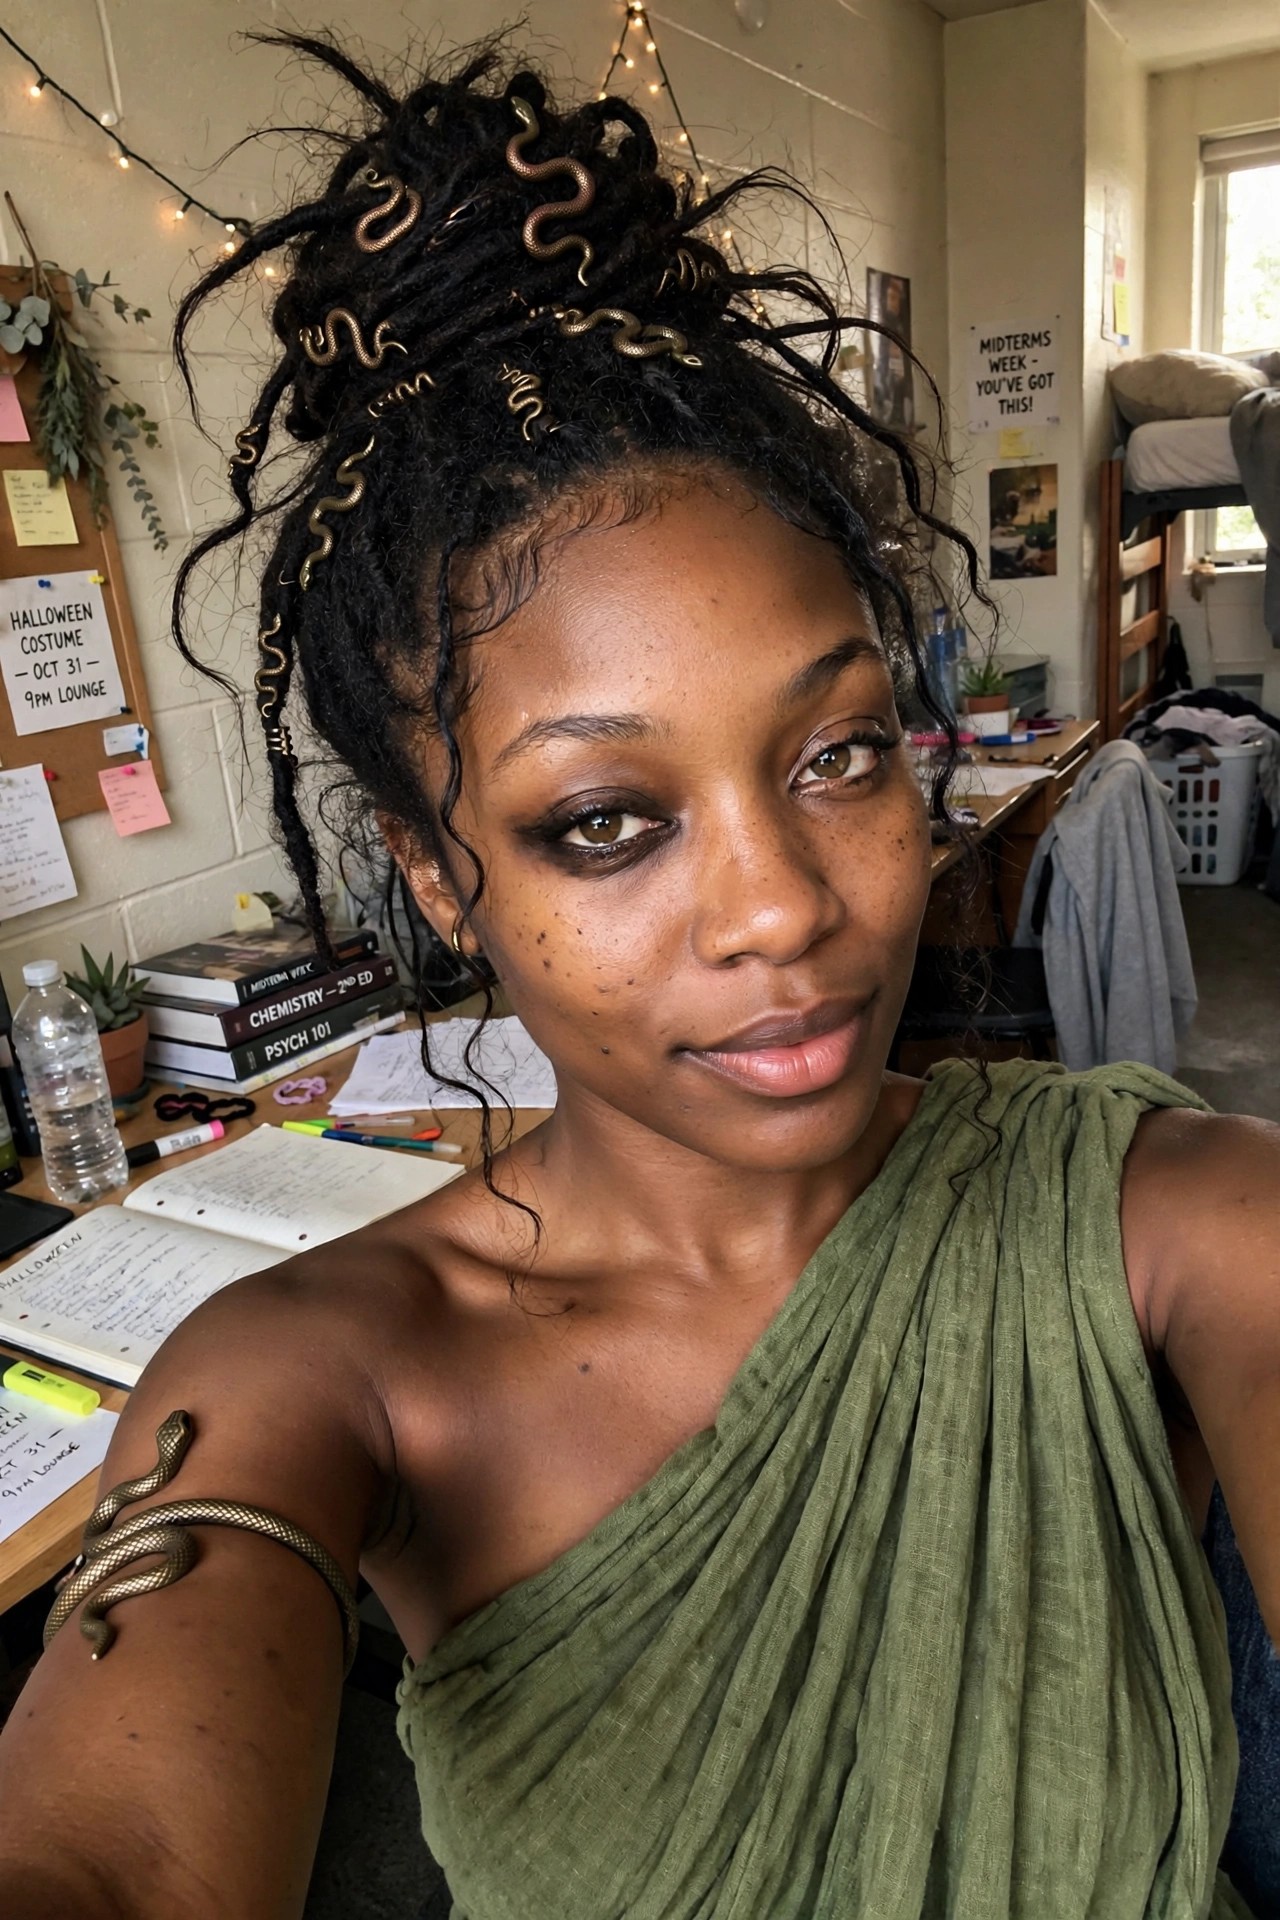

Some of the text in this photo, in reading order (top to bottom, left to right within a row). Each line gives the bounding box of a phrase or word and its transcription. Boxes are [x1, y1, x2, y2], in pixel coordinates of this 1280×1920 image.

[979, 330, 1052, 354] MIDTERMS
[988, 354, 1027, 373] WEEK
[976, 372, 1055, 396] YOU'VE GOT
[998, 396, 1034, 415] THIS!
[10, 602, 94, 631] HALLOWEEN
[20, 629, 84, 655] COSTUME
[33, 660, 59, 680] OCT
[67, 657, 82, 675] 31
[58, 680, 107, 702] LOUNGE
[249, 987, 324, 1028] CHEMISTRY
[337, 976, 357, 994] 2ND
[357, 970, 374, 986] ED
[264, 1030, 309, 1061] PSYCH
[311, 1021, 332, 1041] 101
[24, 1441, 46, 1456] 31
